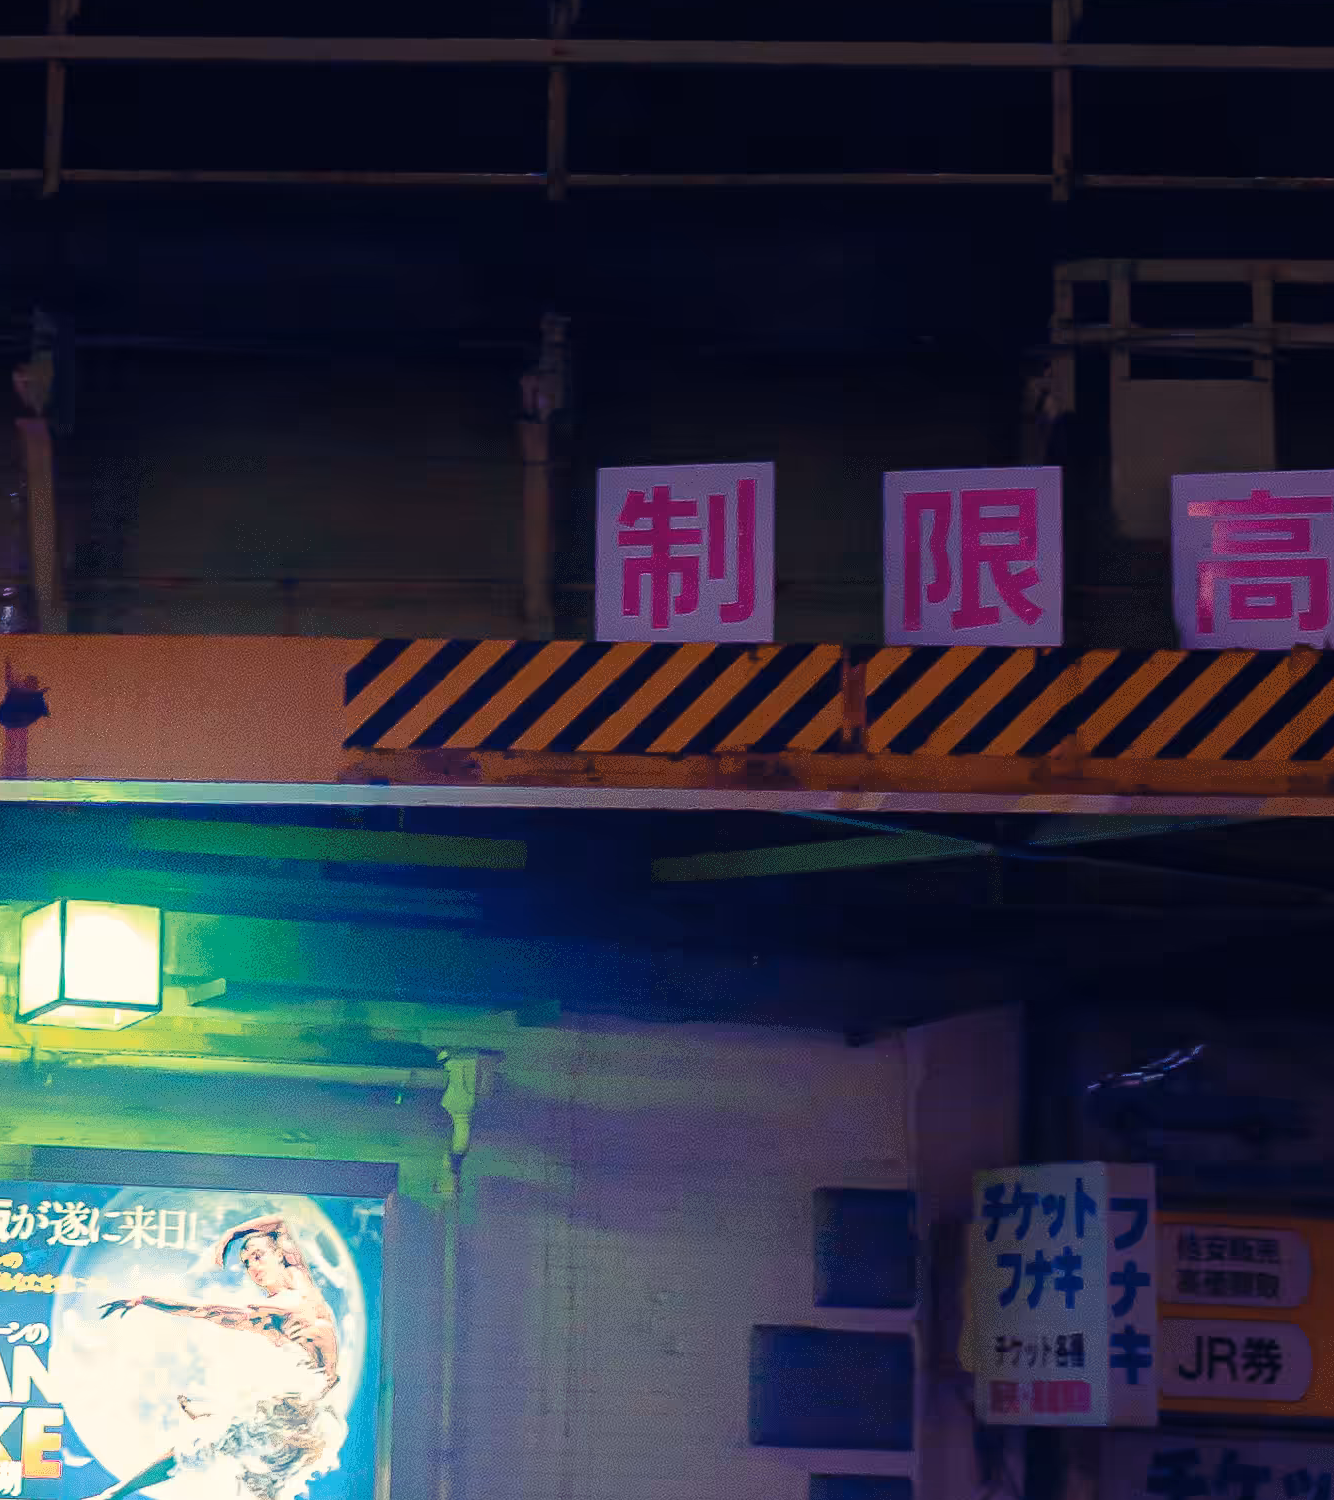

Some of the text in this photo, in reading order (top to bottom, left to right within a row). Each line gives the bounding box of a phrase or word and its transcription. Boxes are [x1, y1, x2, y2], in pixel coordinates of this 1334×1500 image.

[983, 1177, 1096, 1242] チケット
[997, 1246, 1084, 1310] フナキ
[1109, 1198, 1153, 1385] フナキ
[1179, 1335, 1282, 1384] JR券
